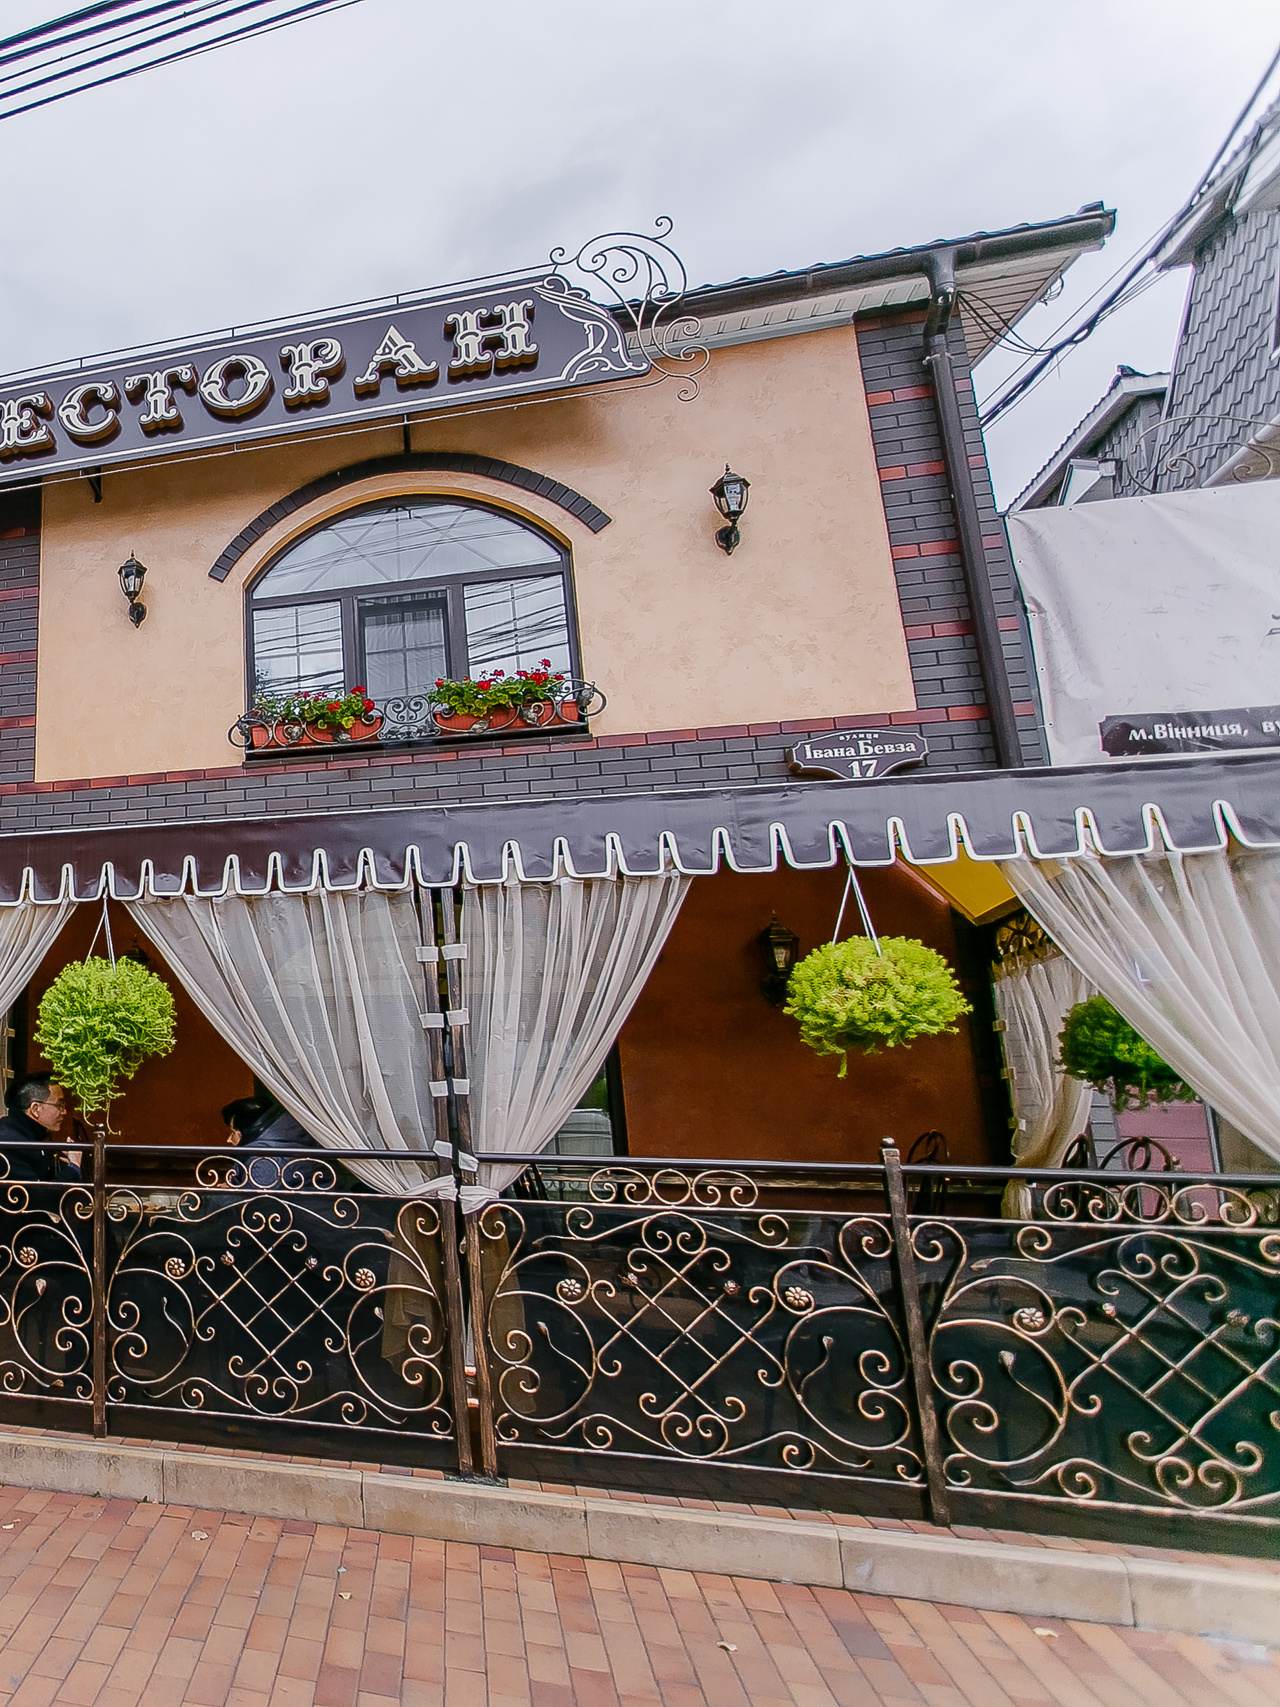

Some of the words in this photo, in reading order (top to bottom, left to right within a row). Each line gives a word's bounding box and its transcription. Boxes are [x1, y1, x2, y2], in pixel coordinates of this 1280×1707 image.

[803, 744, 857, 760] Івана
[857, 739, 917, 757] Бевза
[847, 759, 879, 778] 17
